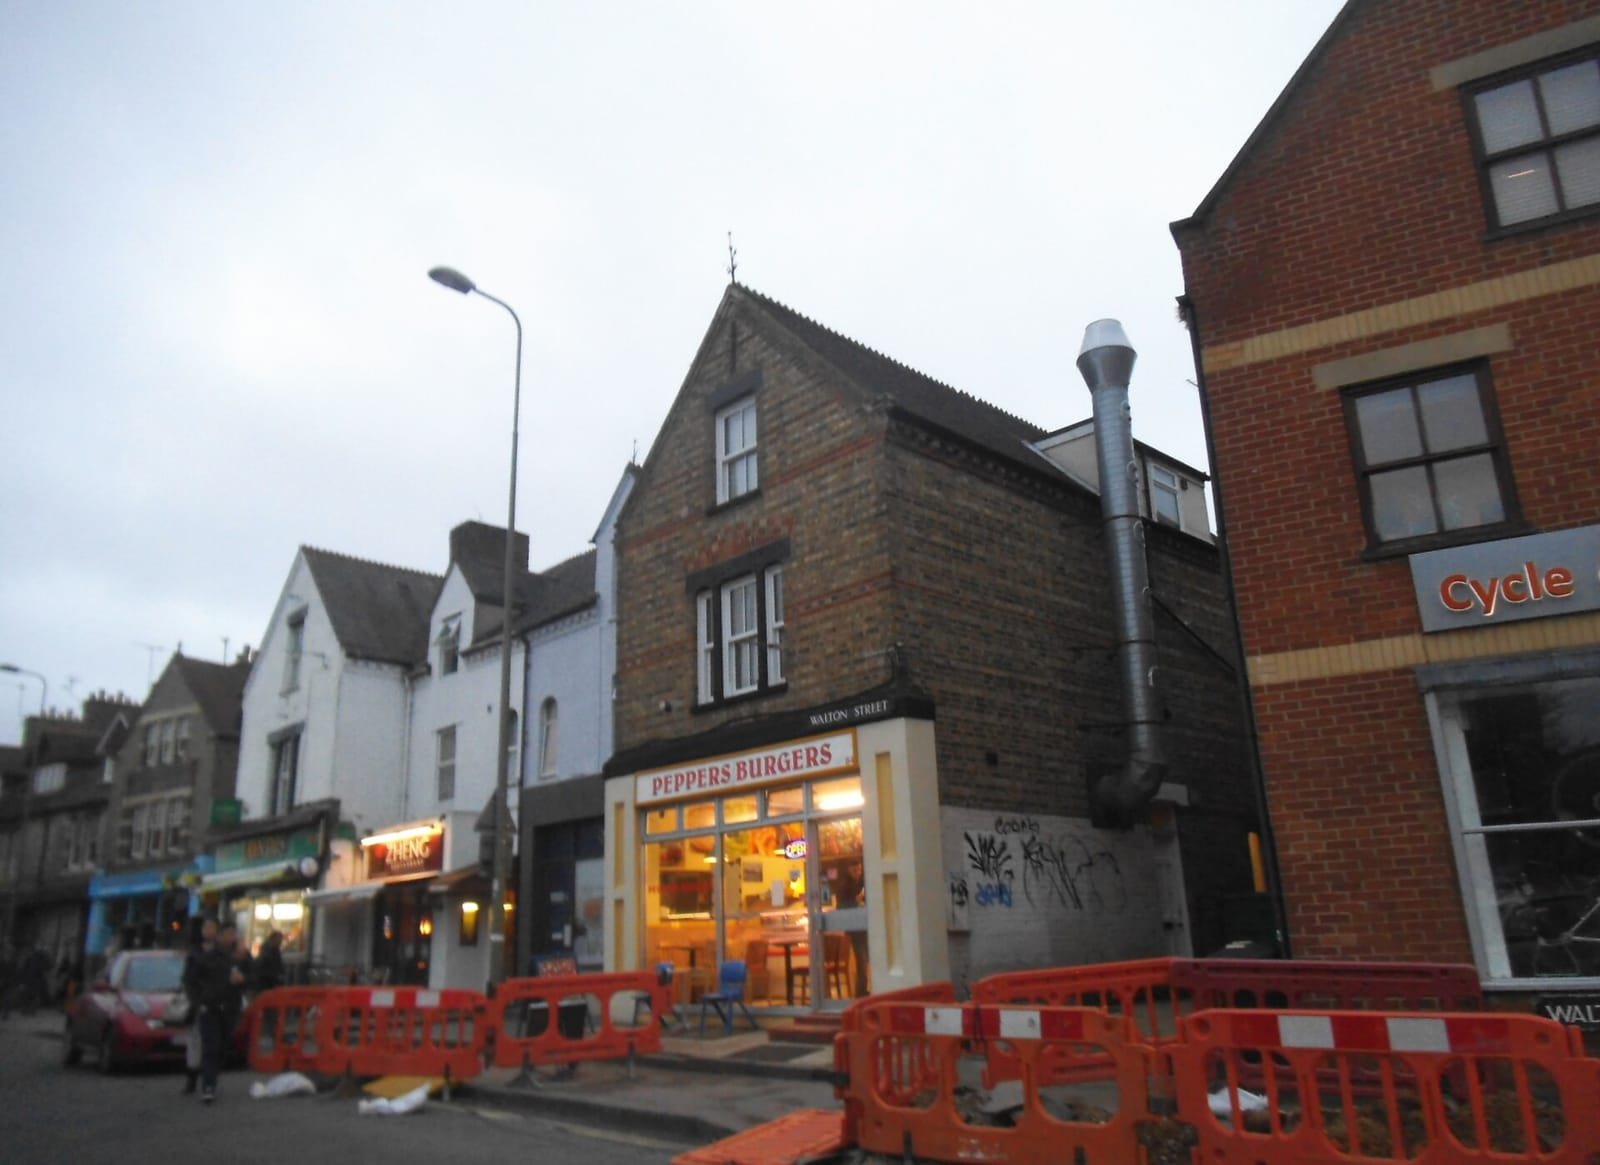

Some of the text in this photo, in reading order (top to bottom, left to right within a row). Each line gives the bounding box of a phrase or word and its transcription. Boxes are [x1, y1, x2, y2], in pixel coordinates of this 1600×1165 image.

[1440, 560, 1575, 616] Cycle
[809, 699, 888, 726] WALTON STREET
[652, 743, 833, 796] PEPPERS BURGERS
[385, 836, 430, 866] ZHENG
[786, 842, 807, 857] OPEN
